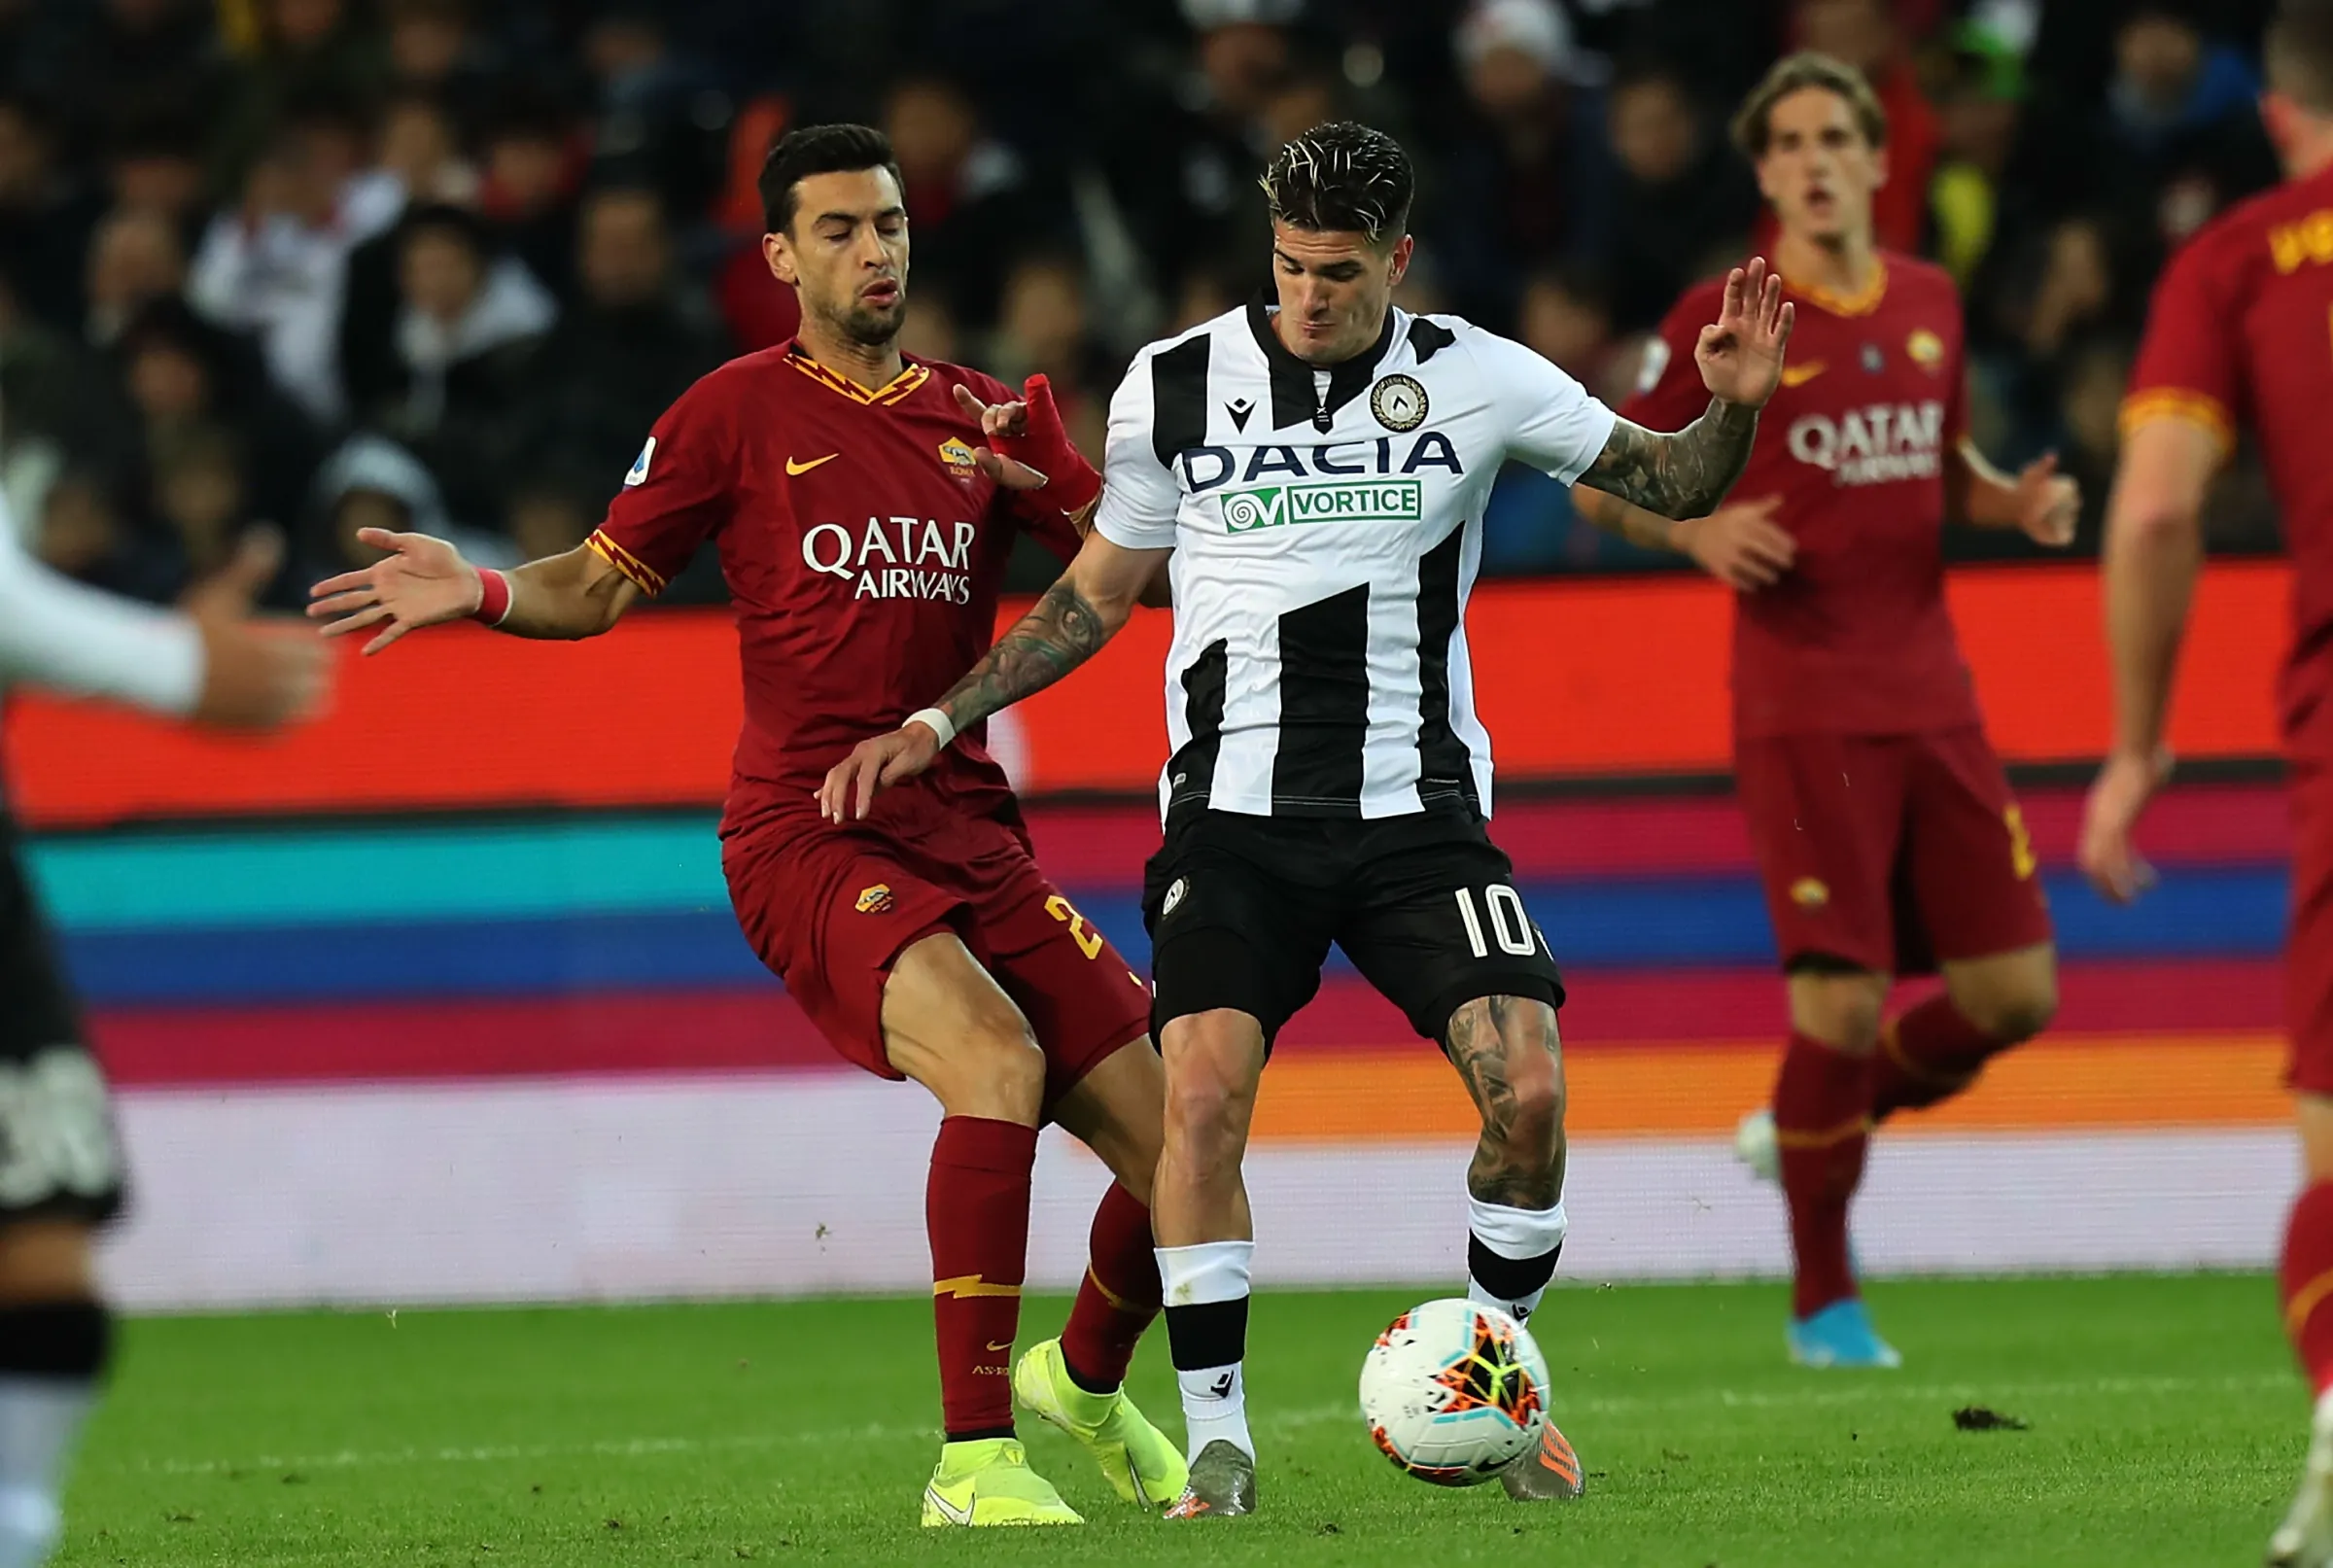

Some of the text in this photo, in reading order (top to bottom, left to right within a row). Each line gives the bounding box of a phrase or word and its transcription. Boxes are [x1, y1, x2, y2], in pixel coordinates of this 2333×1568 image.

[1181, 431, 1464, 494] DACIA
[1294, 489, 1417, 516] VORTICE
[802, 516, 975, 580] QATAR
[854, 570, 971, 607] AIRWAYS
[1454, 884, 1537, 958] 10
